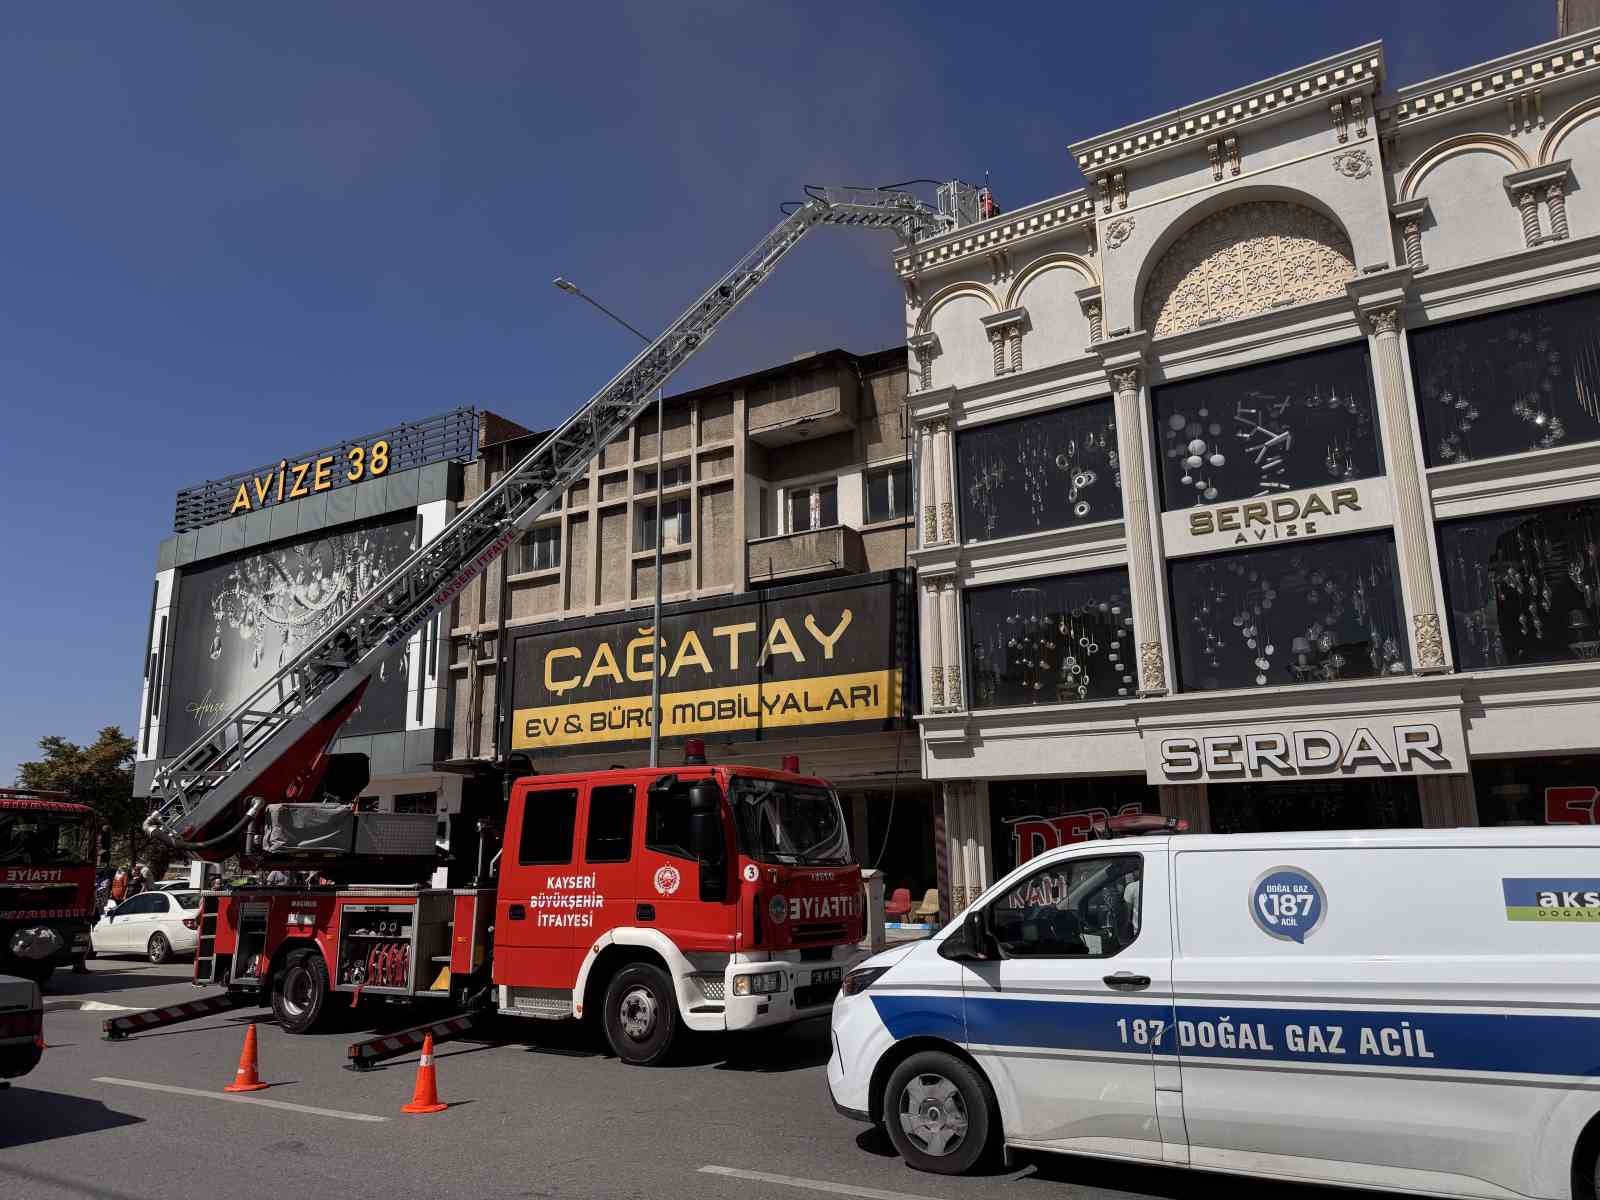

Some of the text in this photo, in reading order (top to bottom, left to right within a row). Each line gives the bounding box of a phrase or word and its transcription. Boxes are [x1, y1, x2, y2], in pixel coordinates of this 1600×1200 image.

[230, 440, 390, 514] AVİZE 38
[1189, 487, 1362, 535] SERDAR
[1234, 522, 1317, 545] AVİZE
[544, 608, 853, 697] ÇAĞATAY
[525, 717, 560, 738] EV
[564, 714, 584, 734] &
[671, 684, 880, 725] MOBİLYALARI
[1160, 723, 1451, 781] SERDAR
[547, 872, 596, 889] KAYSERİ
[747, 867, 756, 879] 3
[1293, 884, 1309, 893] GAZ
[530, 891, 605, 910] BÜYÜKŞEHİR
[1268, 894, 1314, 916] 187
[1117, 1016, 1435, 1058] 187 DOĞAL GAZ ACİL
